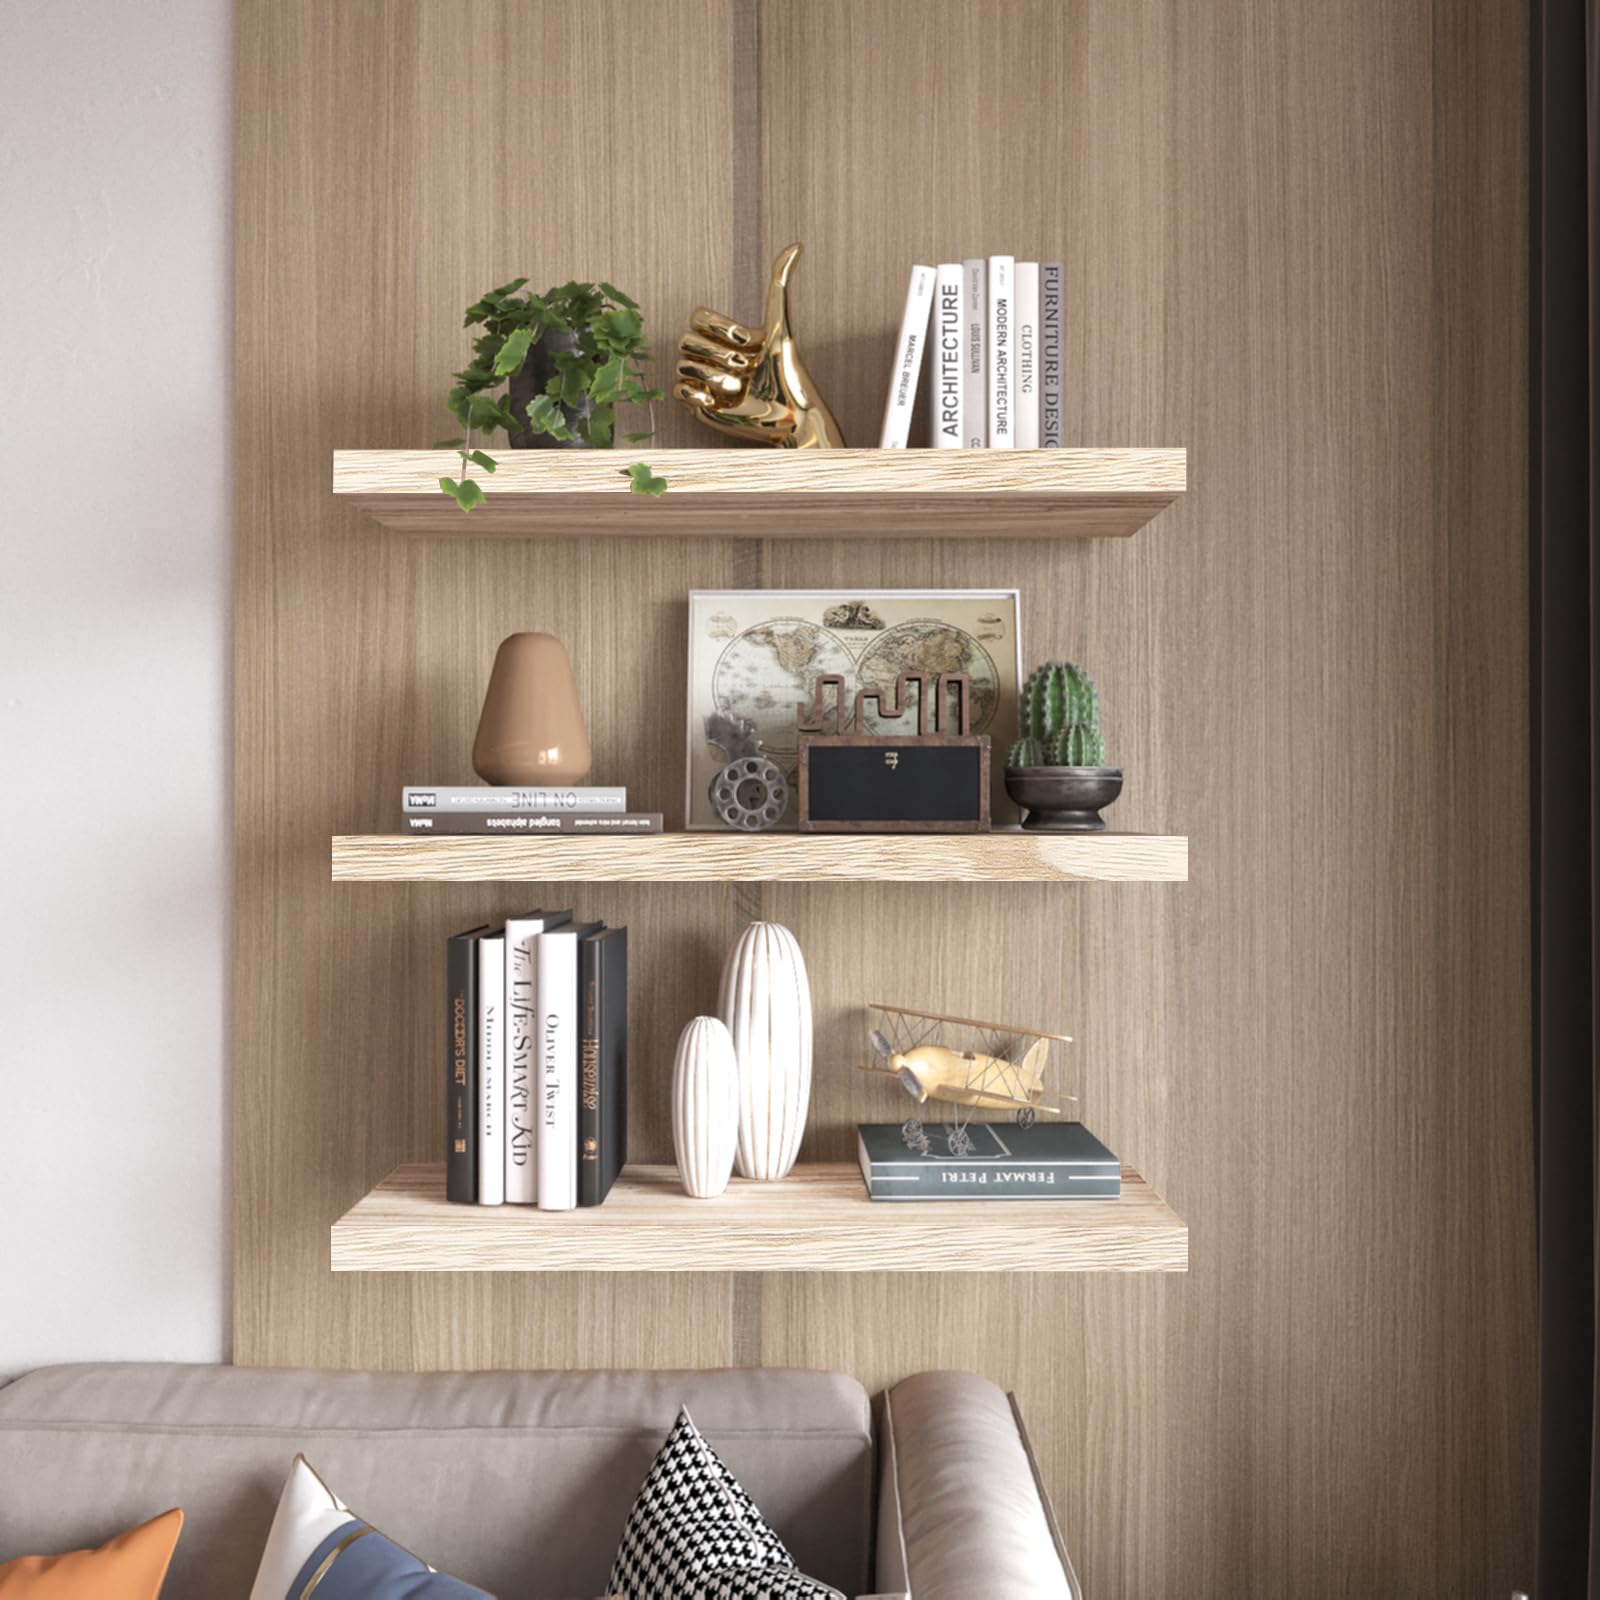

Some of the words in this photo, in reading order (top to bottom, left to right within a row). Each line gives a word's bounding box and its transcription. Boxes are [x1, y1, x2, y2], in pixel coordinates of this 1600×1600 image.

[996, 298, 1008, 347] MODERN
[1045, 266, 1059, 386] FURNITURE
[903, 334, 917, 370] MARCEL
[942, 284, 959, 437] ARCHITECTURE
[1021, 324, 1032, 393] CLOTHING
[897, 371, 911, 407] BREUER
[996, 349, 1008, 435] ARCHITECTURE
[512, 792, 547, 808] LINE
[553, 792, 577, 808] ON
[545, 1013, 560, 1074] OLIVER
[455, 1059, 466, 1086] DIET
[545, 1078, 560, 1129] TWIST
[941, 1172, 988, 1184] PETRI
[994, 1172, 1055, 1185] FERMAT
